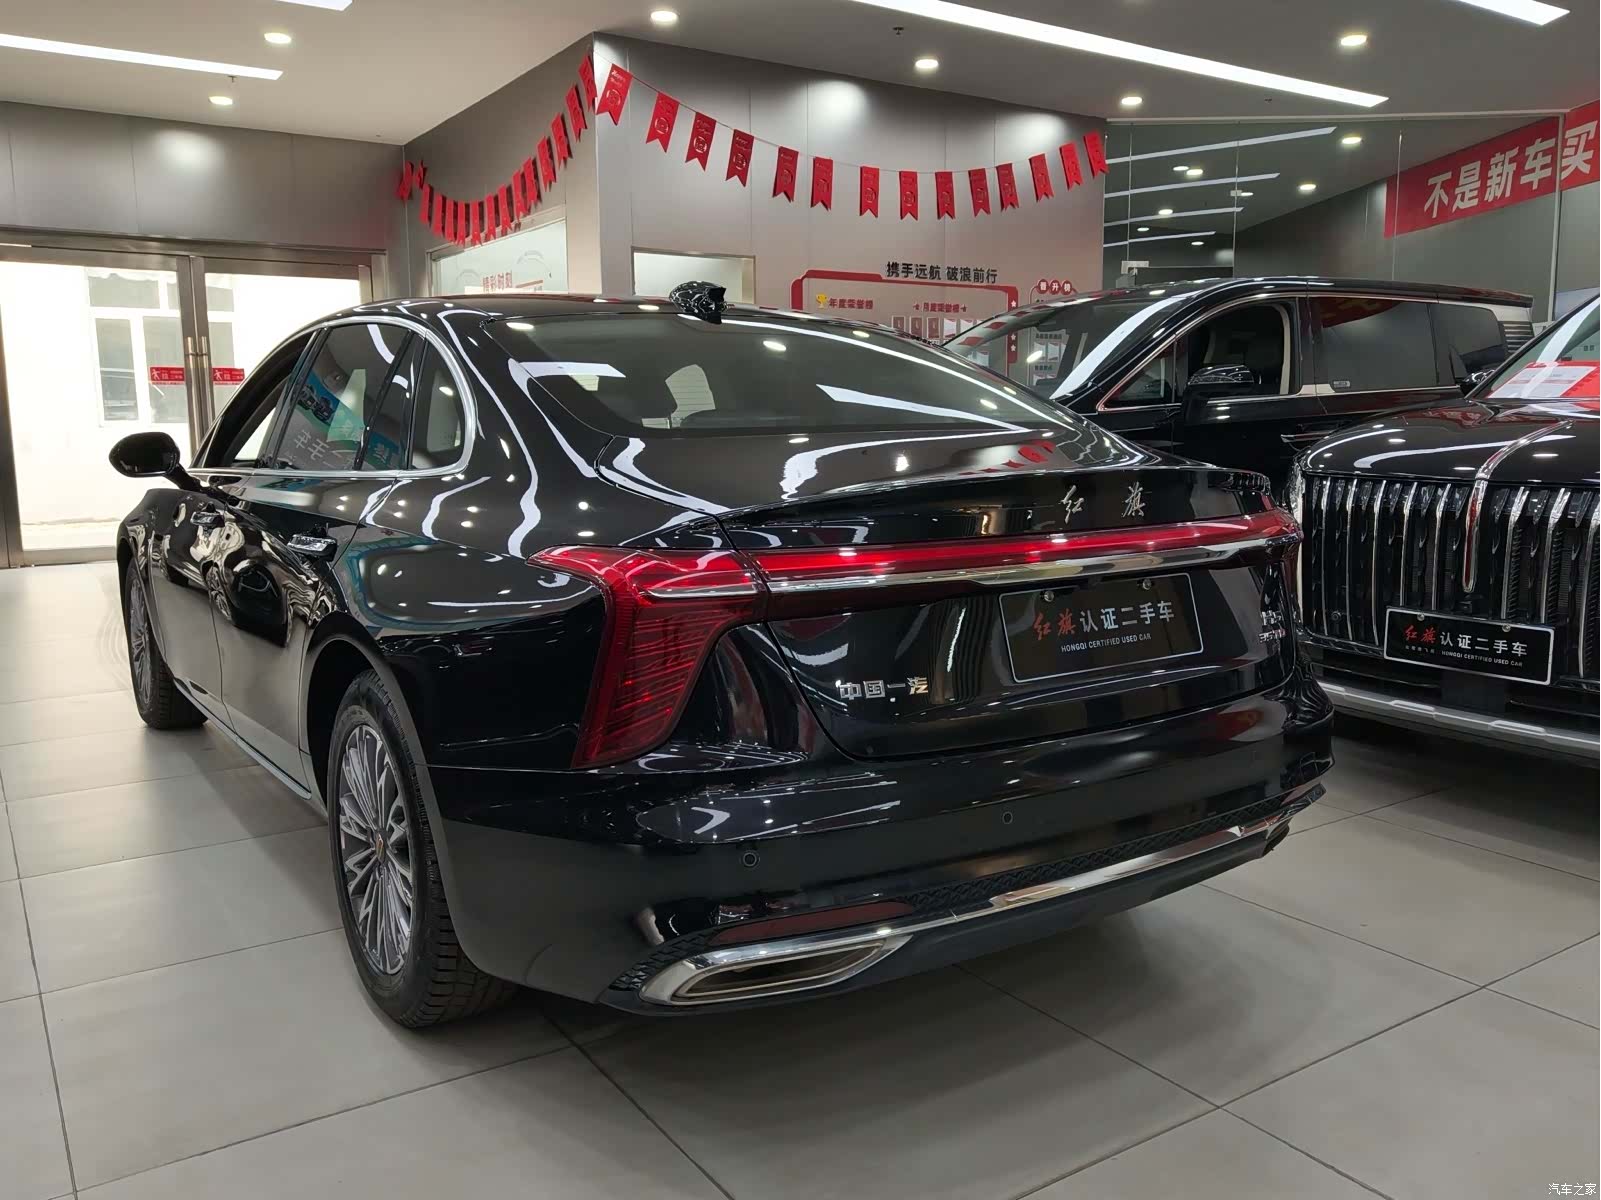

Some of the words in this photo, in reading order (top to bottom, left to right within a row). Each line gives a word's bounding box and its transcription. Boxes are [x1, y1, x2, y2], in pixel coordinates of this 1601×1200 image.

[1424, 120, 1598, 219] 不是新车买
[886, 261, 942, 281] 携手远航
[946, 265, 998, 284] 破浪前行
[1034, 600, 1175, 641] 红旗认证二手车
[1061, 641, 1087, 653] HONGQI
[1088, 637, 1121, 649] CERTIFIED
[1121, 633, 1138, 643] USED
[1138, 632, 1152, 641] CAR
[1404, 624, 1528, 656] 红旗认证二手车
[1441, 650, 1463, 658] HONGQI
[1463, 653, 1493, 663] CERTIFIED
[1494, 657, 1509, 665] USED
[839, 676, 929, 701] 中国一汽
